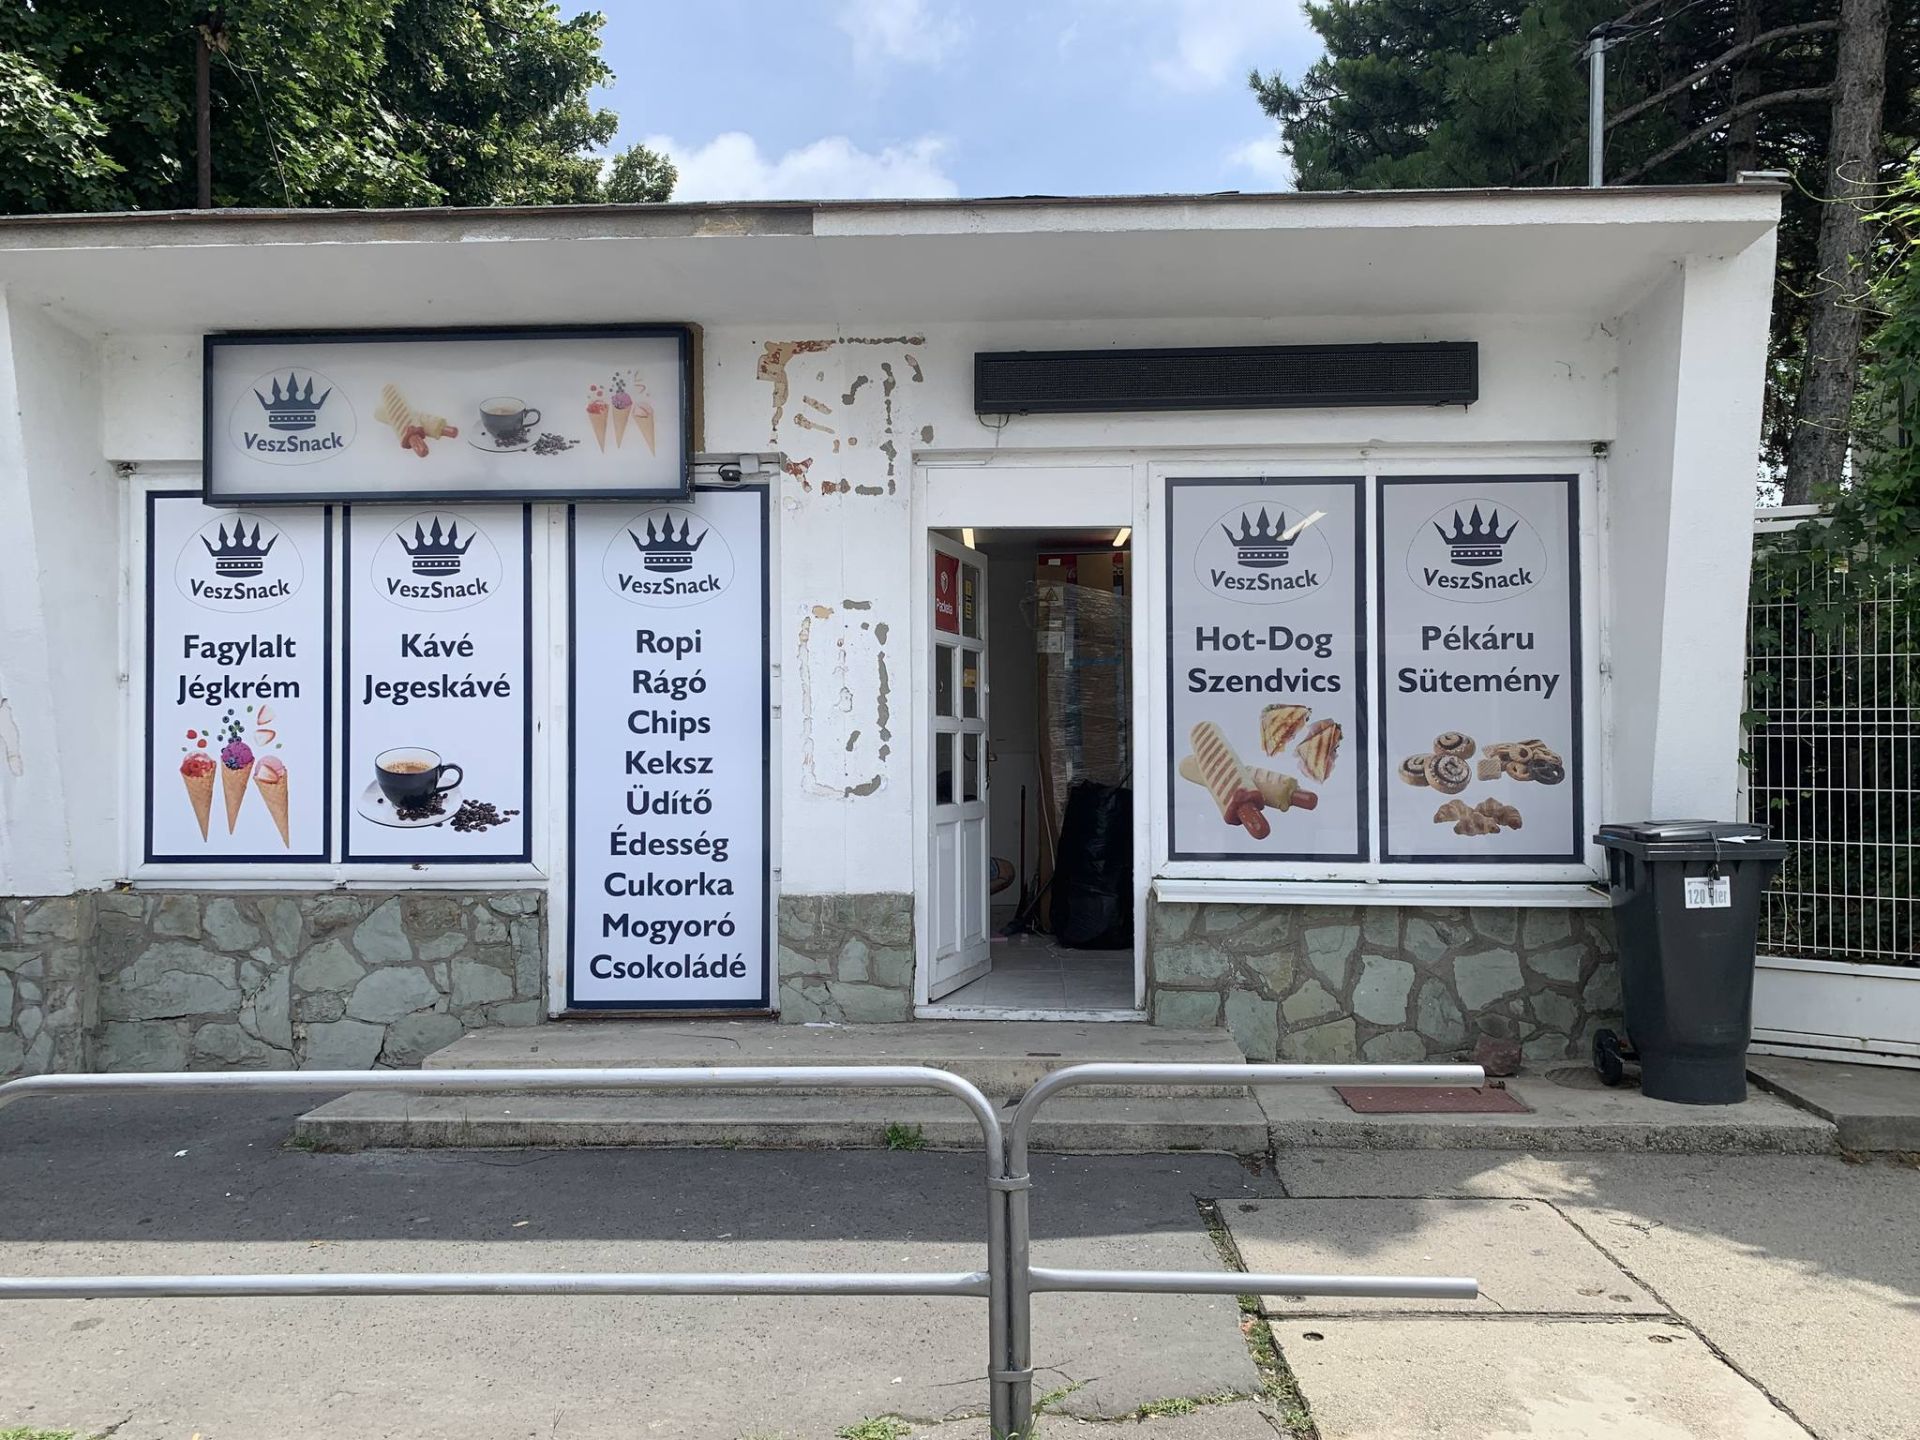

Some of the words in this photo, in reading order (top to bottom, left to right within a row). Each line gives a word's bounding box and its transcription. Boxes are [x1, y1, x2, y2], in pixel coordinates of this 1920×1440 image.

[243, 431, 344, 453] VeszSnack
[190, 578, 291, 600] VeszSnack
[386, 577, 489, 599] VeszSnack
[618, 574, 721, 596] VeszSnack
[1210, 568, 1319, 591] VeszSnack
[1423, 567, 1533, 590] VeszSnack
[183, 633, 297, 666] Fagylalt
[401, 632, 474, 658] Kávé
[636, 628, 702, 661] Ropi
[1196, 625, 1333, 658] Hot-Dog
[1421, 624, 1534, 652] Pékáru
[177, 673, 300, 706] Jégkrém
[363, 673, 511, 706] Jegeskávé
[632, 668, 707, 701] Rágó
[1188, 667, 1341, 694] Szendvics
[1398, 666, 1560, 699] Sütemény
[627, 709, 711, 741] Chips
[625, 750, 714, 775] Keksz
[626, 784, 713, 816] Üdítő
[610, 824, 729, 862] Édesség
[604, 871, 734, 897] Cukorka
[1688, 889, 1706, 904] 120
[602, 911, 736, 945] Mogyoró
[589, 952, 747, 980] Csokoládé
